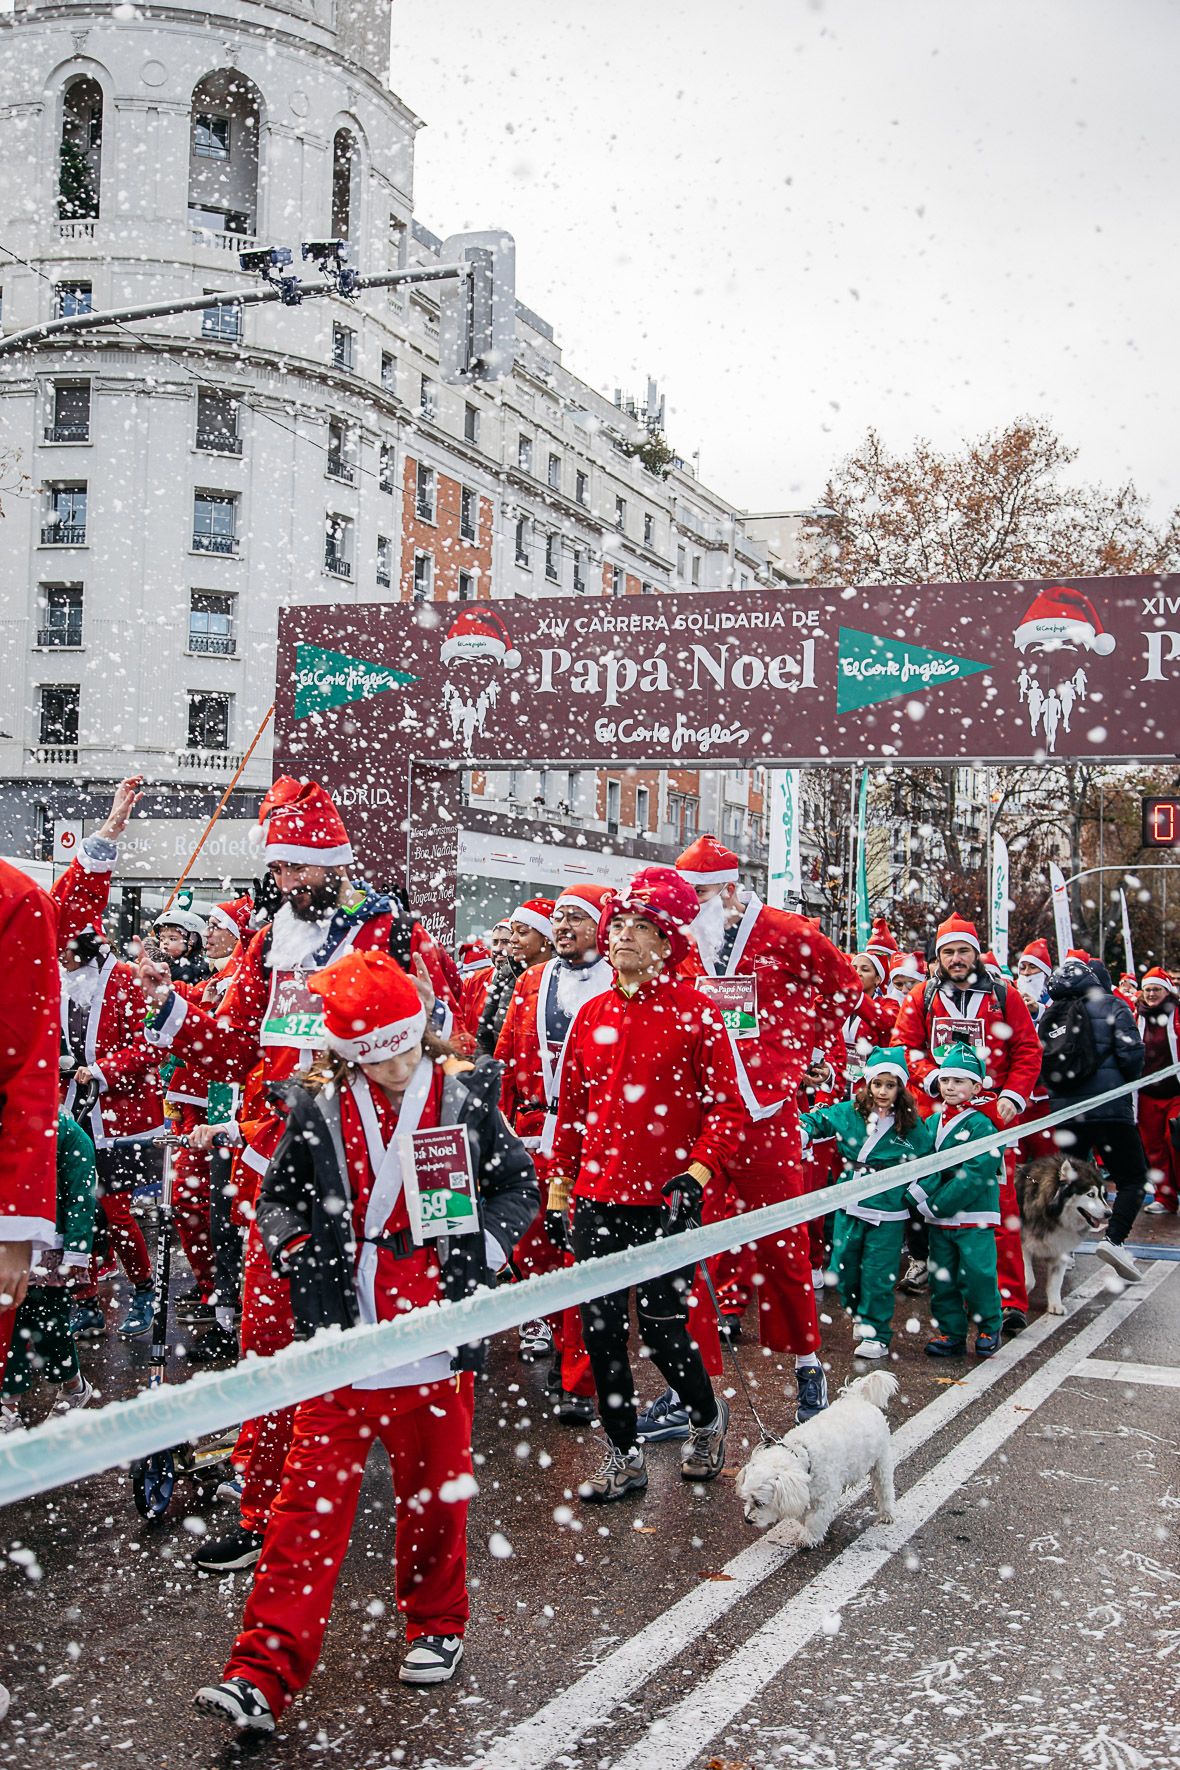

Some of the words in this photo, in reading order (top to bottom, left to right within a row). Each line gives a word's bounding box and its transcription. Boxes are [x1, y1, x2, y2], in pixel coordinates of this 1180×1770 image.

[1142, 597, 1180, 615] XIV
[537, 618, 570, 635] XIV
[575, 615, 669, 632] CARRERA
[674, 612, 785, 629] SOLIDARIA
[792, 610, 820, 626] DE
[300, 669, 313, 686] El
[313, 669, 346, 686] Corte
[346, 665, 395, 692] Inglés
[533, 642, 672, 707] Papá
[687, 639, 818, 691] Noel
[843, 658, 860, 676] El
[861, 658, 900, 676] Corte
[901, 653, 960, 682] Inglés
[595, 717, 618, 743] El
[618, 719, 670, 743] Corte
[672, 713, 750, 752] Inglés
[331, 788, 391, 805] ADRID
[175, 835, 264, 856] Recoleto
[352, 1027, 410, 1056] Diego
